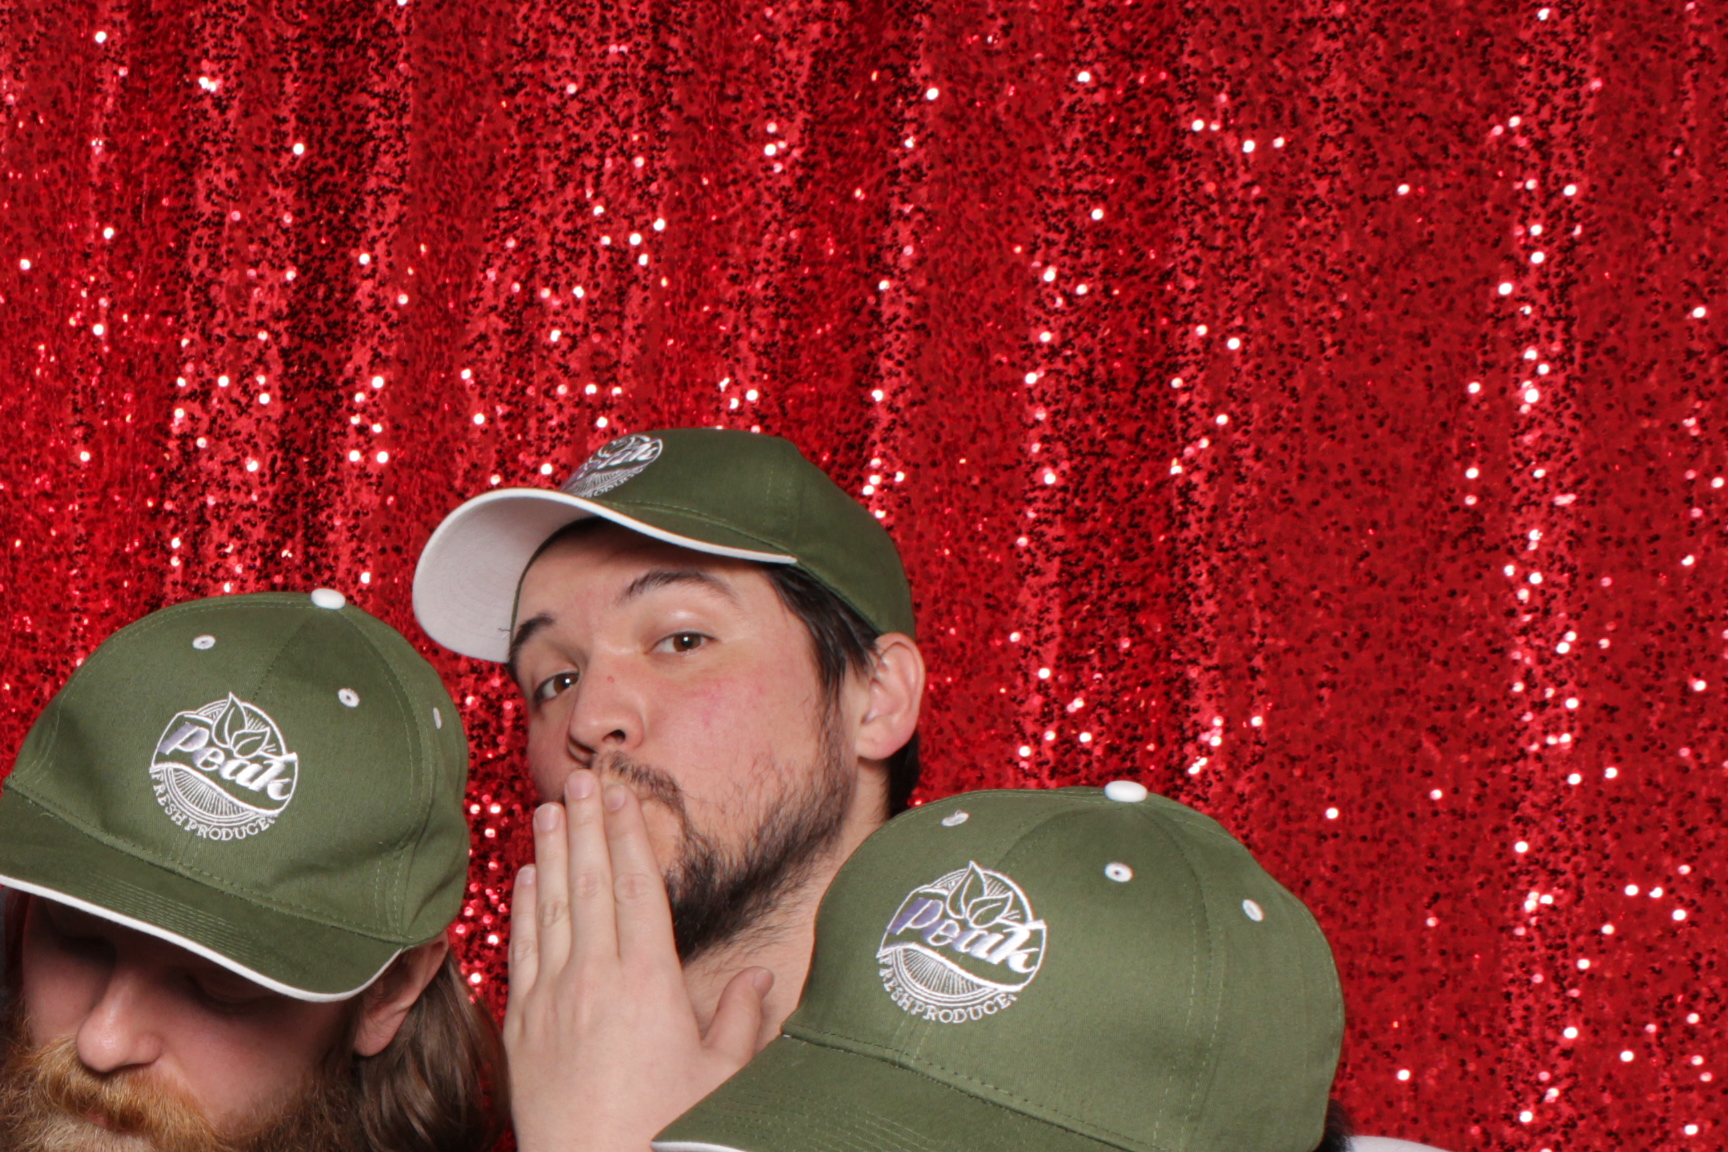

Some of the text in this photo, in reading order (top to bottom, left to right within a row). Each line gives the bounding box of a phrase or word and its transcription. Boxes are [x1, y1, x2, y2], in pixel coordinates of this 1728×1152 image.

[158, 722, 292, 801] Peak
[184, 816, 271, 841] PRODUCE
[887, 897, 1040, 974] Peak
[911, 994, 1011, 1023] PRODUCE
